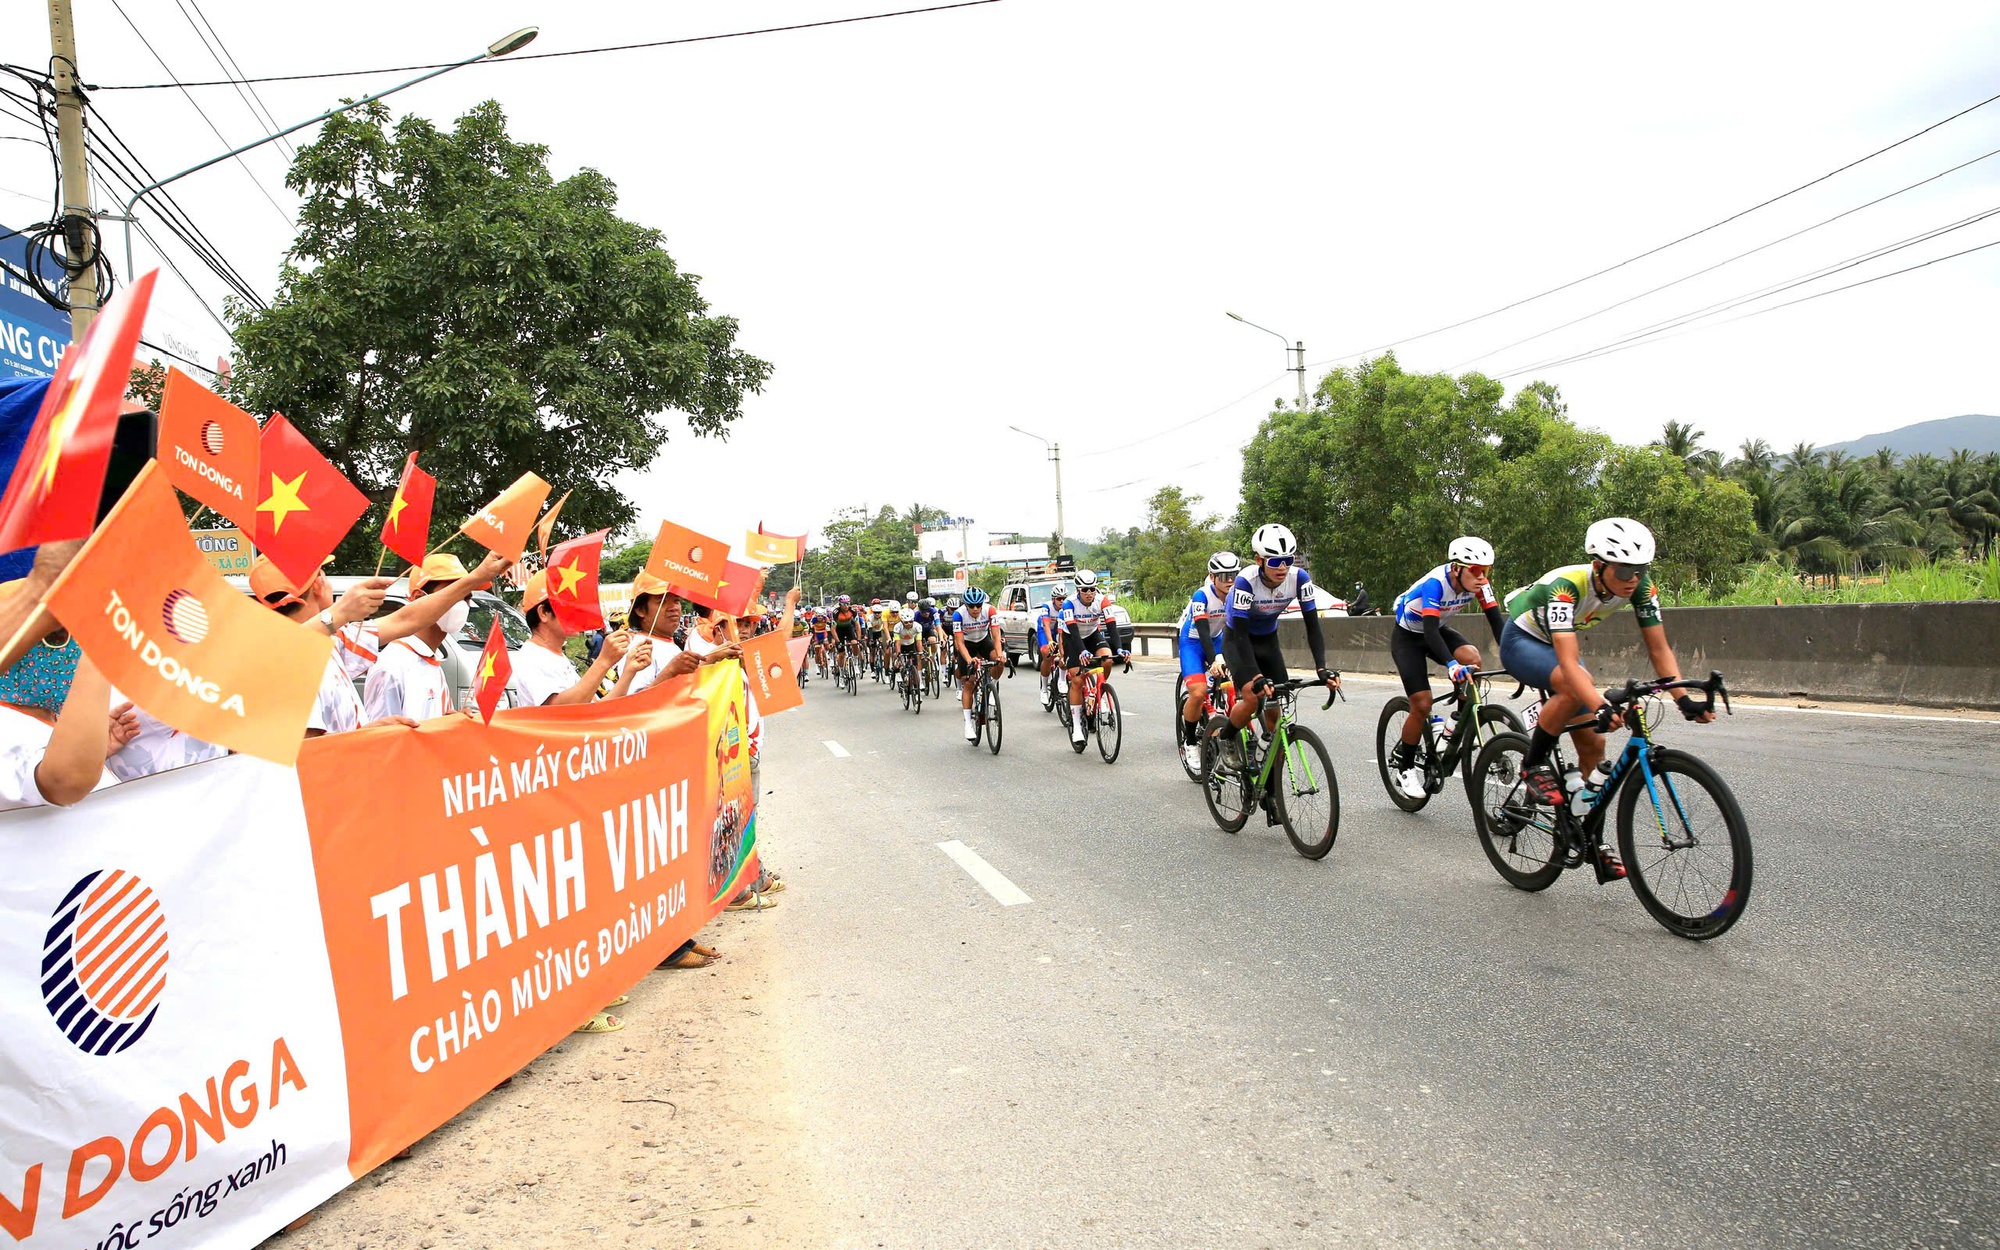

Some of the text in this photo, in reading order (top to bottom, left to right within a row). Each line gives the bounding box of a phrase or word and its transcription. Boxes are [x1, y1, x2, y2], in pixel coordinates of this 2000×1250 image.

[174, 445, 243, 501] TON DONG A
[494, 520, 505, 534] A
[664, 558, 709, 583] TON DONG A
[1235, 593, 1252, 606] 106
[1551, 606, 1568, 623] 55
[104, 589, 247, 718] TON DONG A
[753, 649, 772, 700] TON DONG A
[1527, 705, 1540, 724] 55
[441, 754, 508, 818] NHÀ
[509, 743, 563, 795] MÁY
[566, 733, 608, 783] CÁN
[369, 778, 689, 1002] THÀNH VINH
[409, 877, 687, 1074] CHÀO MỪNG ĐOÀN ĐUA
[61, 1059, 260, 1221] DONG
[269, 1036, 308, 1110] A
[147, 1179, 223, 1239] sống
[222, 1138, 287, 1199] xanh
